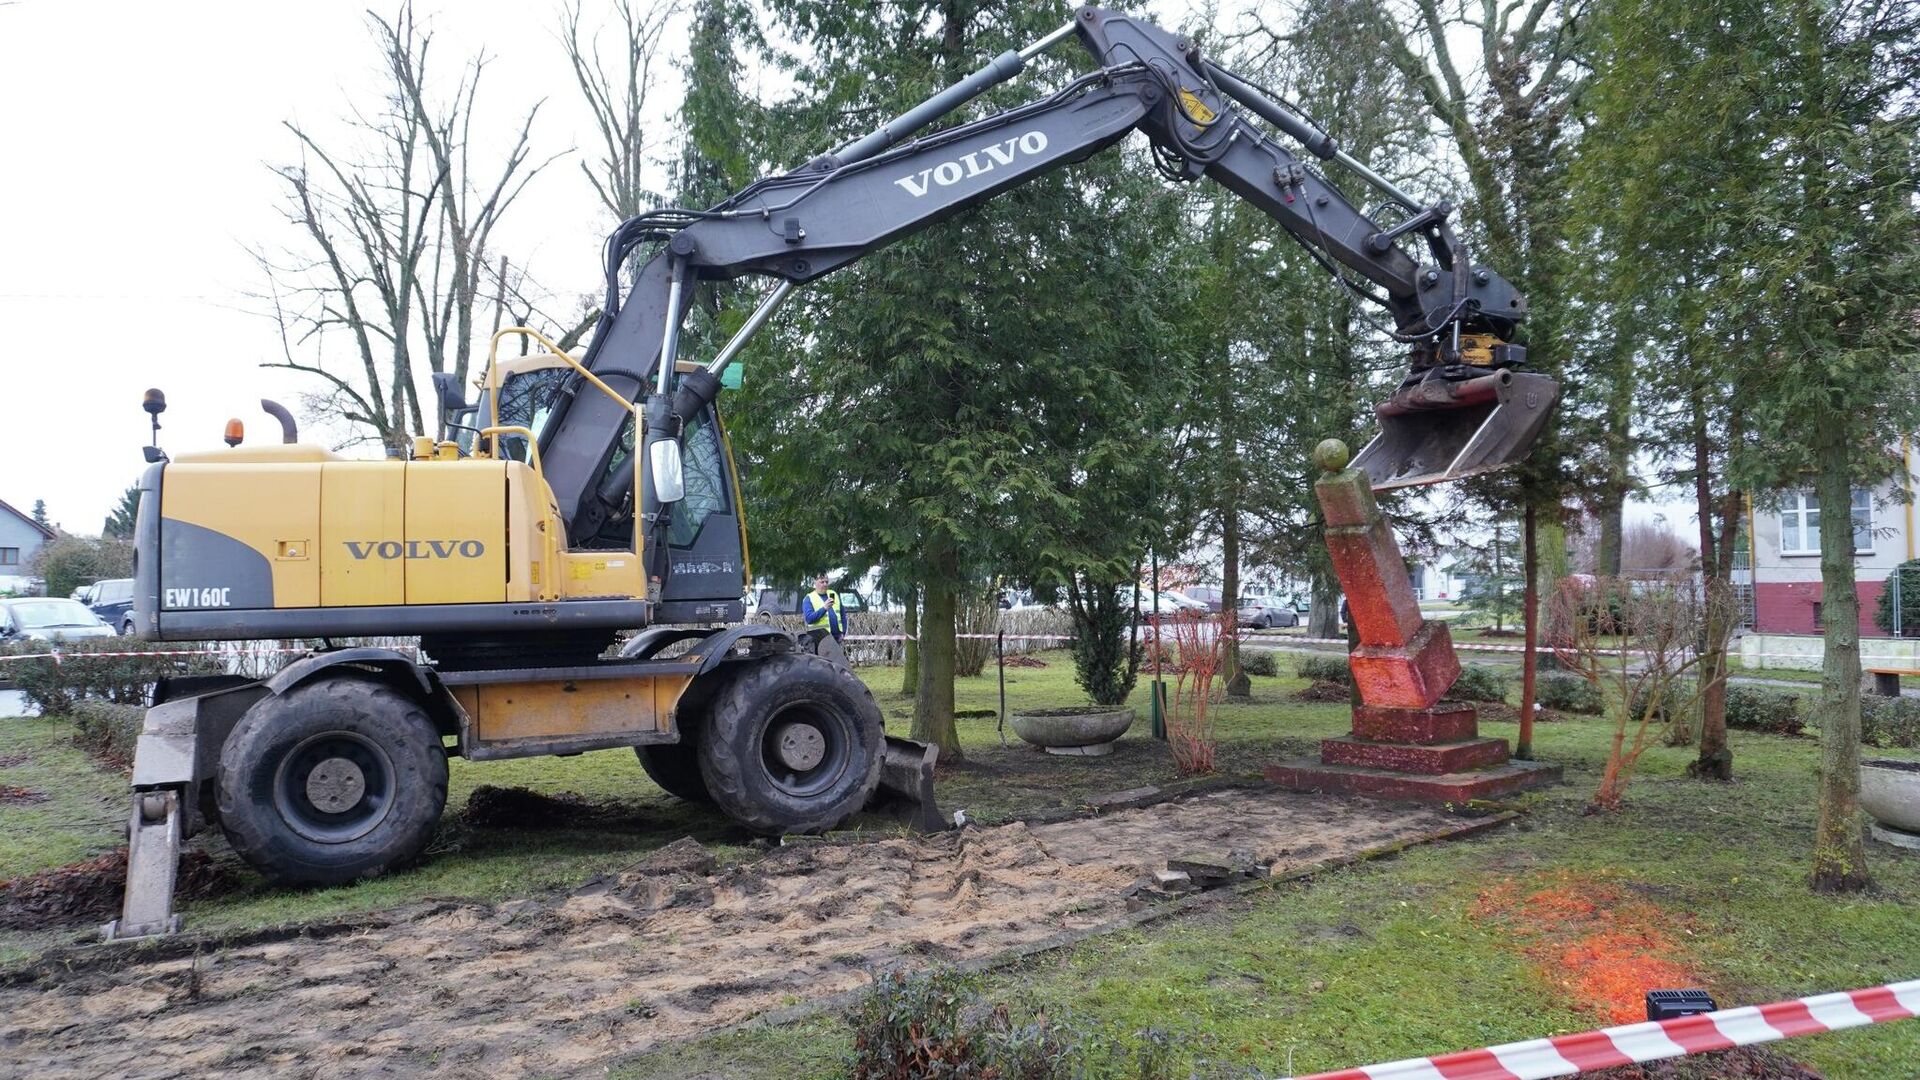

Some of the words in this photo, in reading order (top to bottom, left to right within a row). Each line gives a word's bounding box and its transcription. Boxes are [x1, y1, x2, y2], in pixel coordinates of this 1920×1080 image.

[894, 130, 1048, 198] VOLVO
[342, 539, 485, 560] VOLVO
[165, 587, 231, 608] EW160C
